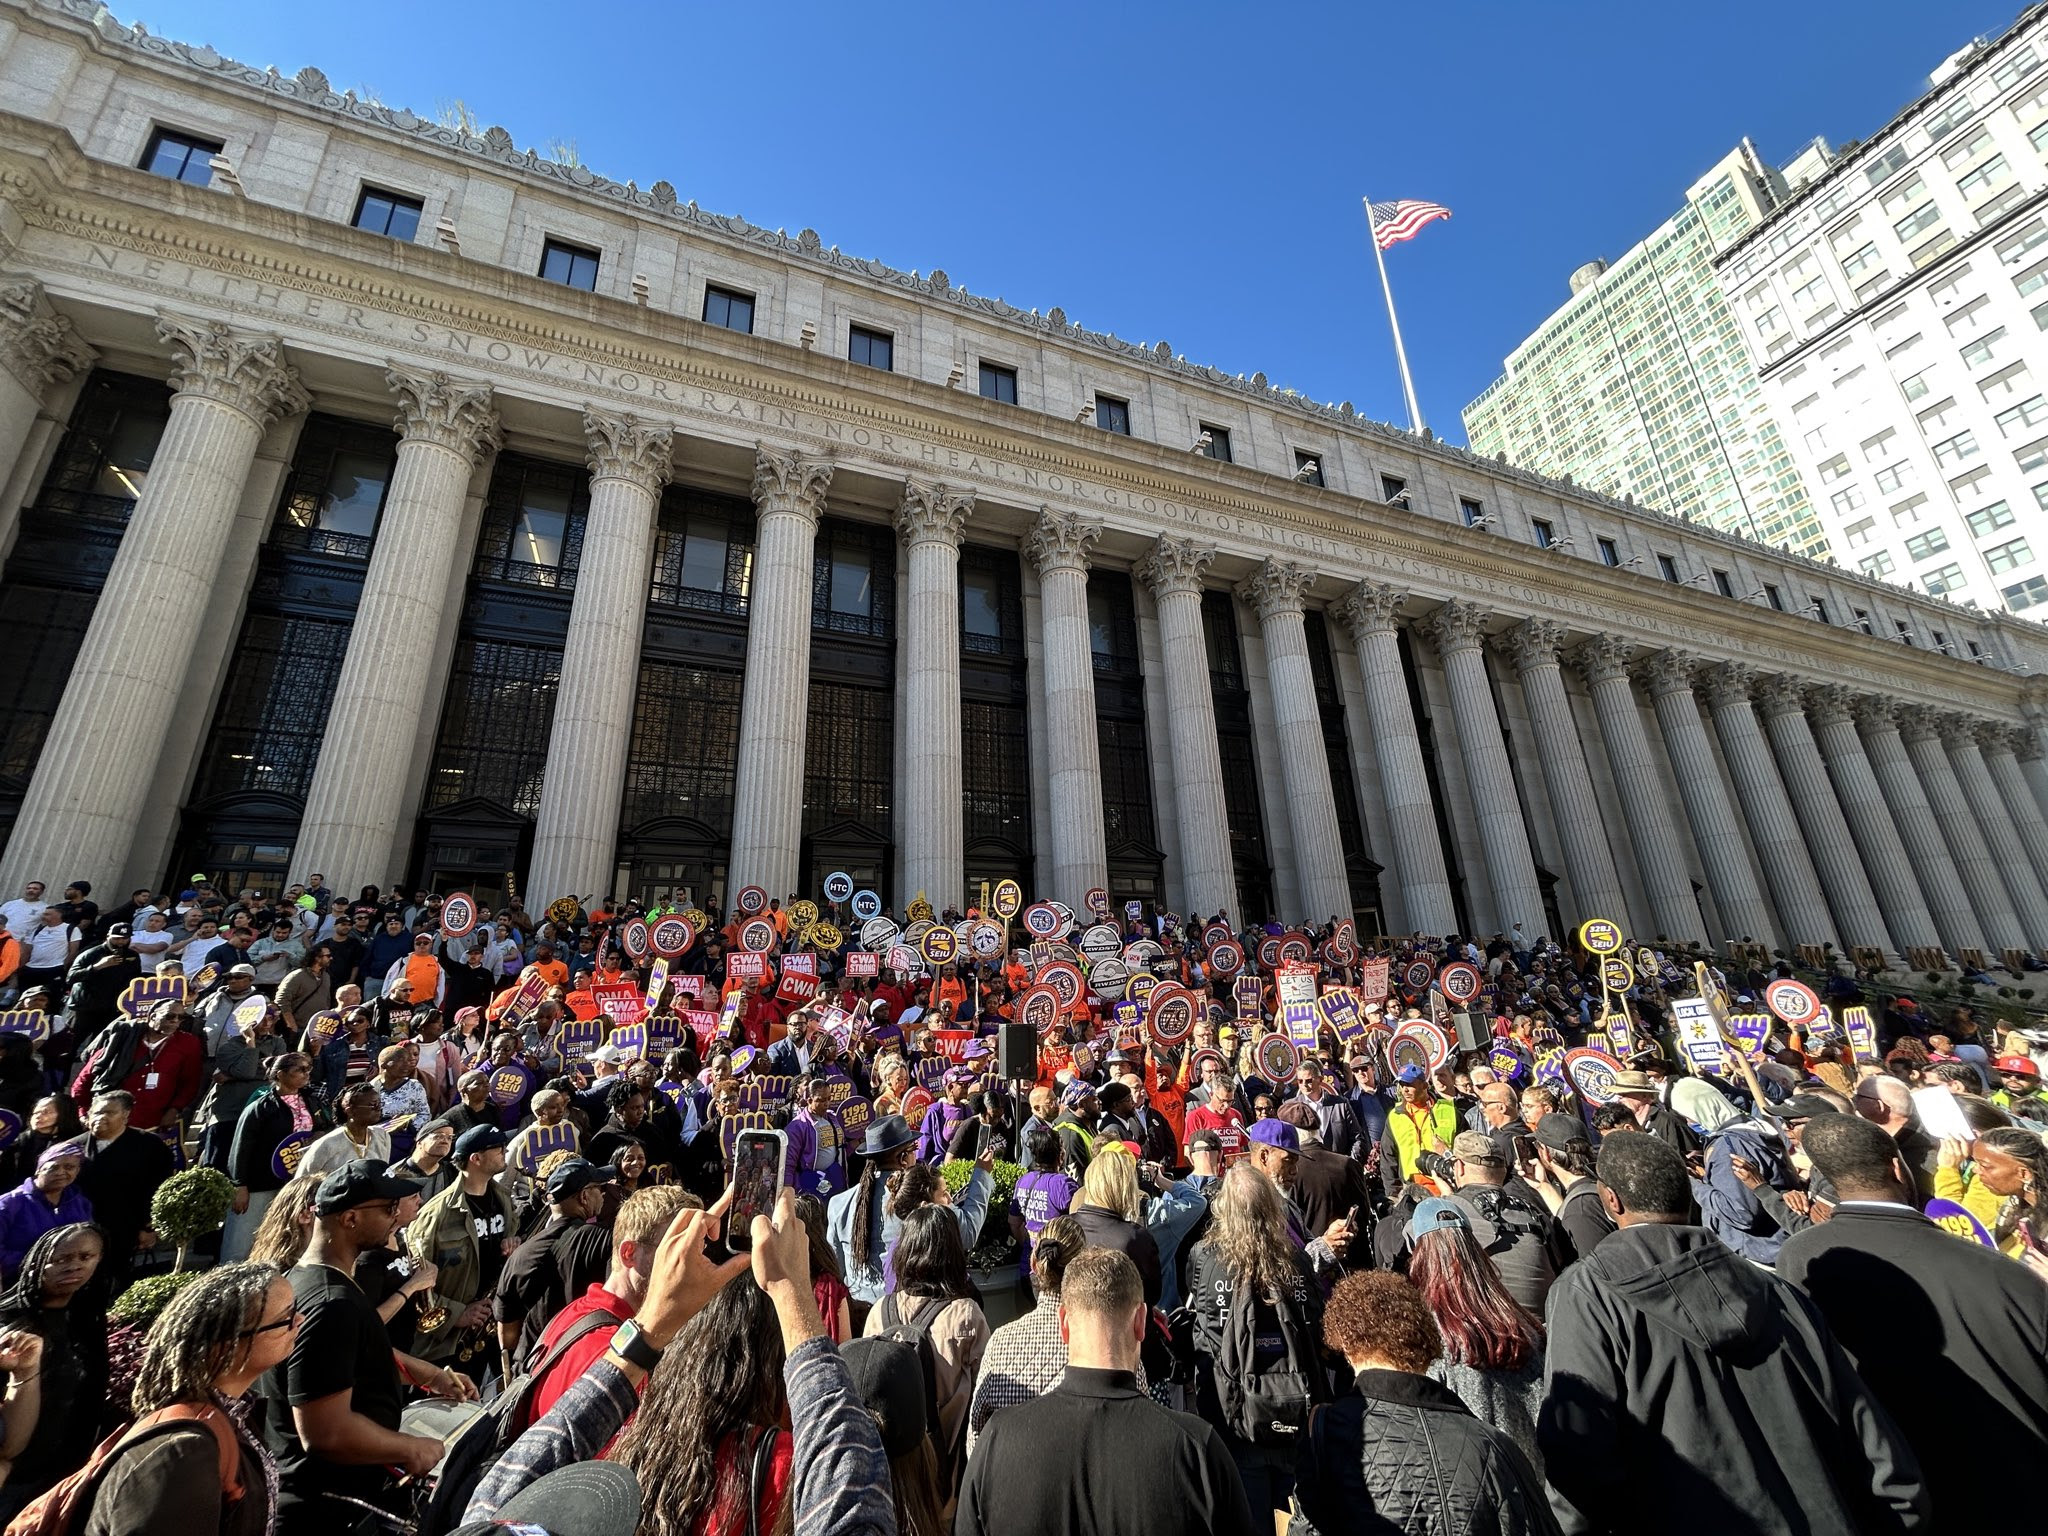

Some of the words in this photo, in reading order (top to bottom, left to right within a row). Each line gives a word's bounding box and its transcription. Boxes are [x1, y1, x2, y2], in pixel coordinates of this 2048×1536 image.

[84, 243, 372, 330] NEITHER
[411, 322, 553, 370] SNOW
[581, 363, 680, 401] NOR
[701, 392, 798, 428] RAIN
[824, 422, 901, 452] NOR
[920, 444, 1005, 477] HEAT
[1024, 468, 1087, 497] NOR
[1104, 488, 1200, 524] GLOOM
[1217, 515, 1245, 533] OF
[1262, 524, 1347, 556] NIGHT
[1355, 549, 1421, 575] STAYS
[1431, 566, 1497, 593] THESE
[1508, 585, 1606, 618] COURIERS
[1614, 610, 1661, 631] FROM
[1669, 623, 1698, 639] THE
[830, 883, 848, 892] HTC
[858, 901, 875, 910] HTC
[731, 954, 762, 964] CWA
[784, 955, 812, 964] CWA
[850, 955, 875, 964] CWA
[731, 964, 762, 973] STRONG
[850, 963, 875, 973] STRONG
[670, 976, 700, 987] CWA
[1094, 978, 1127, 987] RWDSU
[1134, 980, 1153, 989] 32BJ
[783, 977, 814, 998] CWA
[604, 1001, 639, 1012] CWA
[1117, 1005, 1136, 1014] 1199
[390, 1010, 412, 1018] HANDS
[1120, 1011, 1137, 1019] SEIU
[1163, 1010, 1188, 1028] 79
[317, 1016, 340, 1027] 1199
[314, 1023, 337, 1035] SEIU
[935, 1039, 967, 1055] CWA
[498, 1073, 523, 1085] 1199
[495, 1082, 521, 1093] SEIU
[829, 1082, 851, 1093] 1199
[842, 1102, 867, 1118] 1199
[844, 1111, 868, 1127] SEIU
[1034, 1190, 1048, 1199] CARE
[1935, 1215, 1974, 1236] 1199
[1284, 1276, 1305, 1288] ARE
[1216, 1295, 1226, 1306] &
